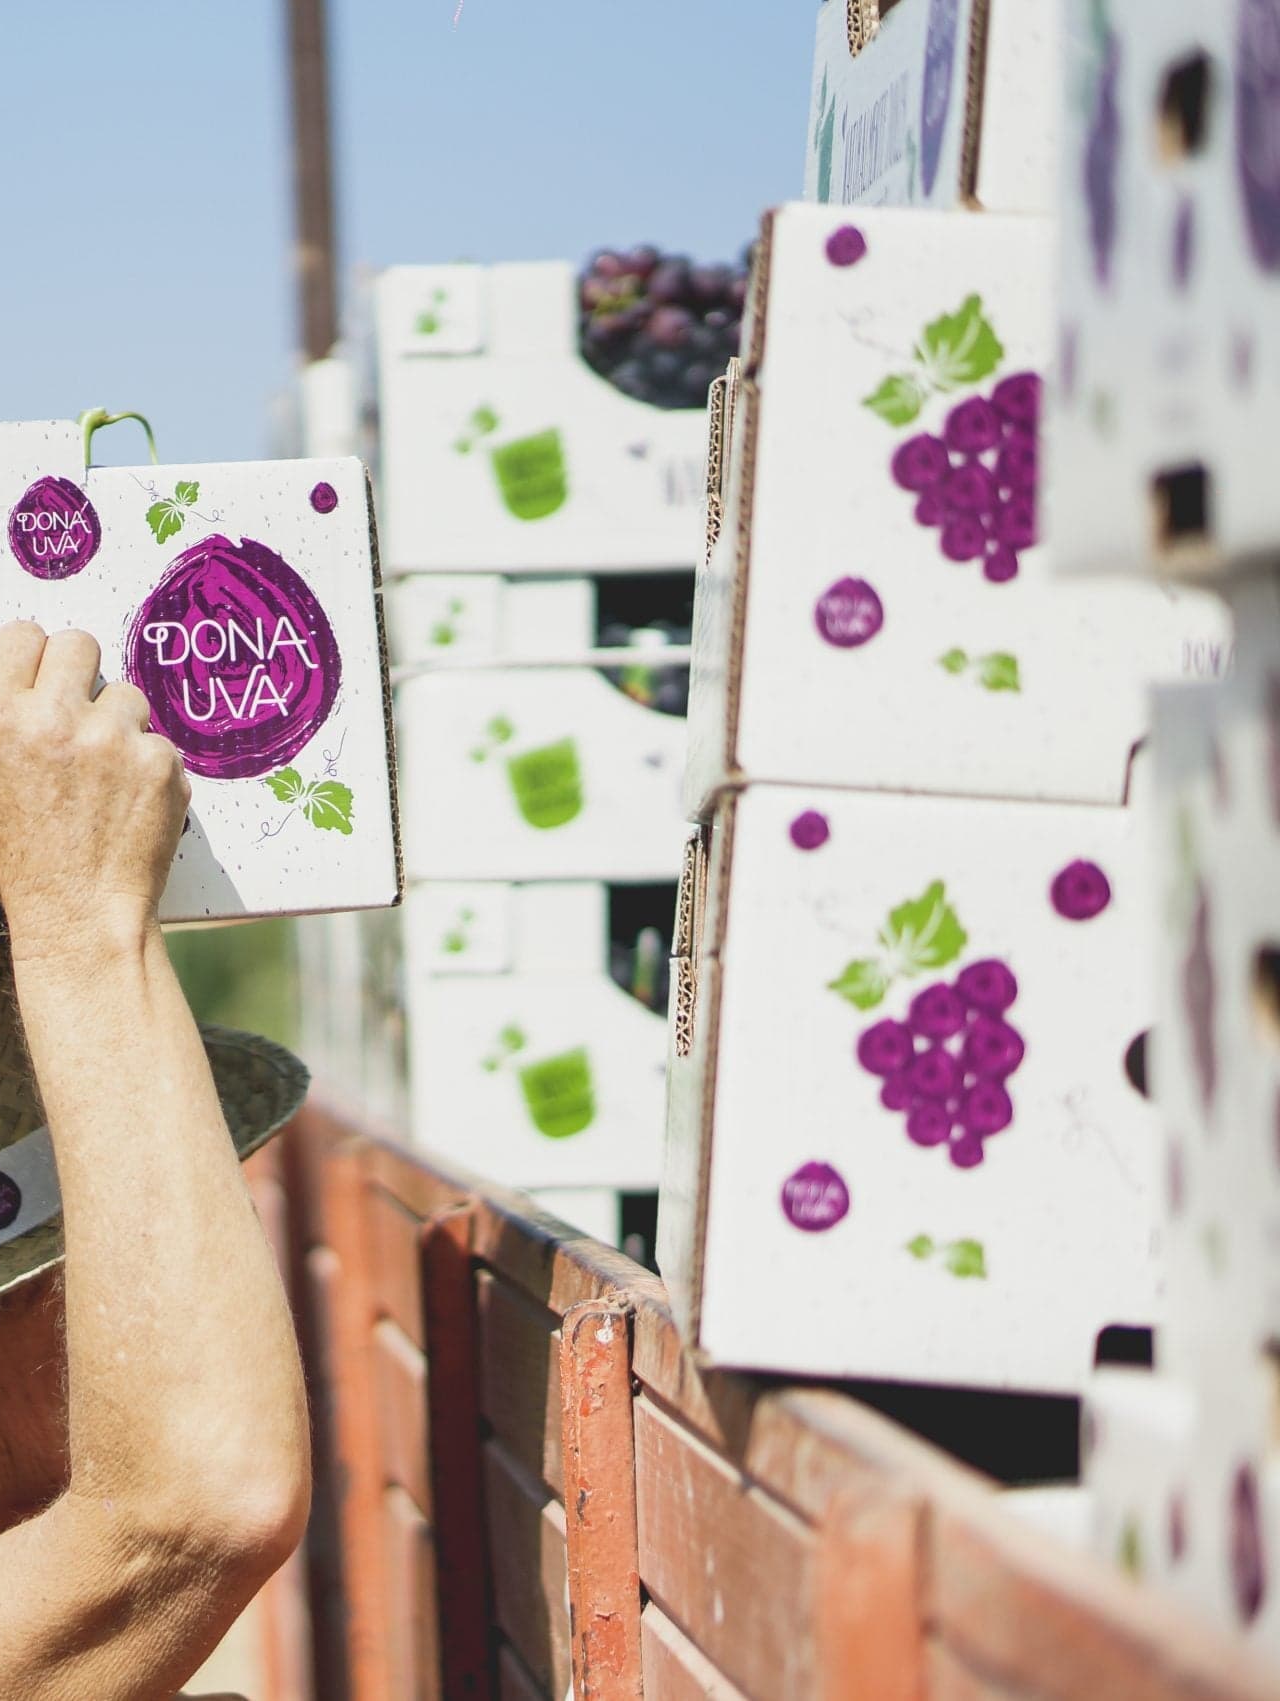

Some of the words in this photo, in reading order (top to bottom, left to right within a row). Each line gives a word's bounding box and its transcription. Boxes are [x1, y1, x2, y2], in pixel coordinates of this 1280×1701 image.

[16, 511, 91, 533] DONA
[32, 531, 81, 555] UVA
[143, 615, 318, 669] DONA
[182, 664, 294, 722] UVA
